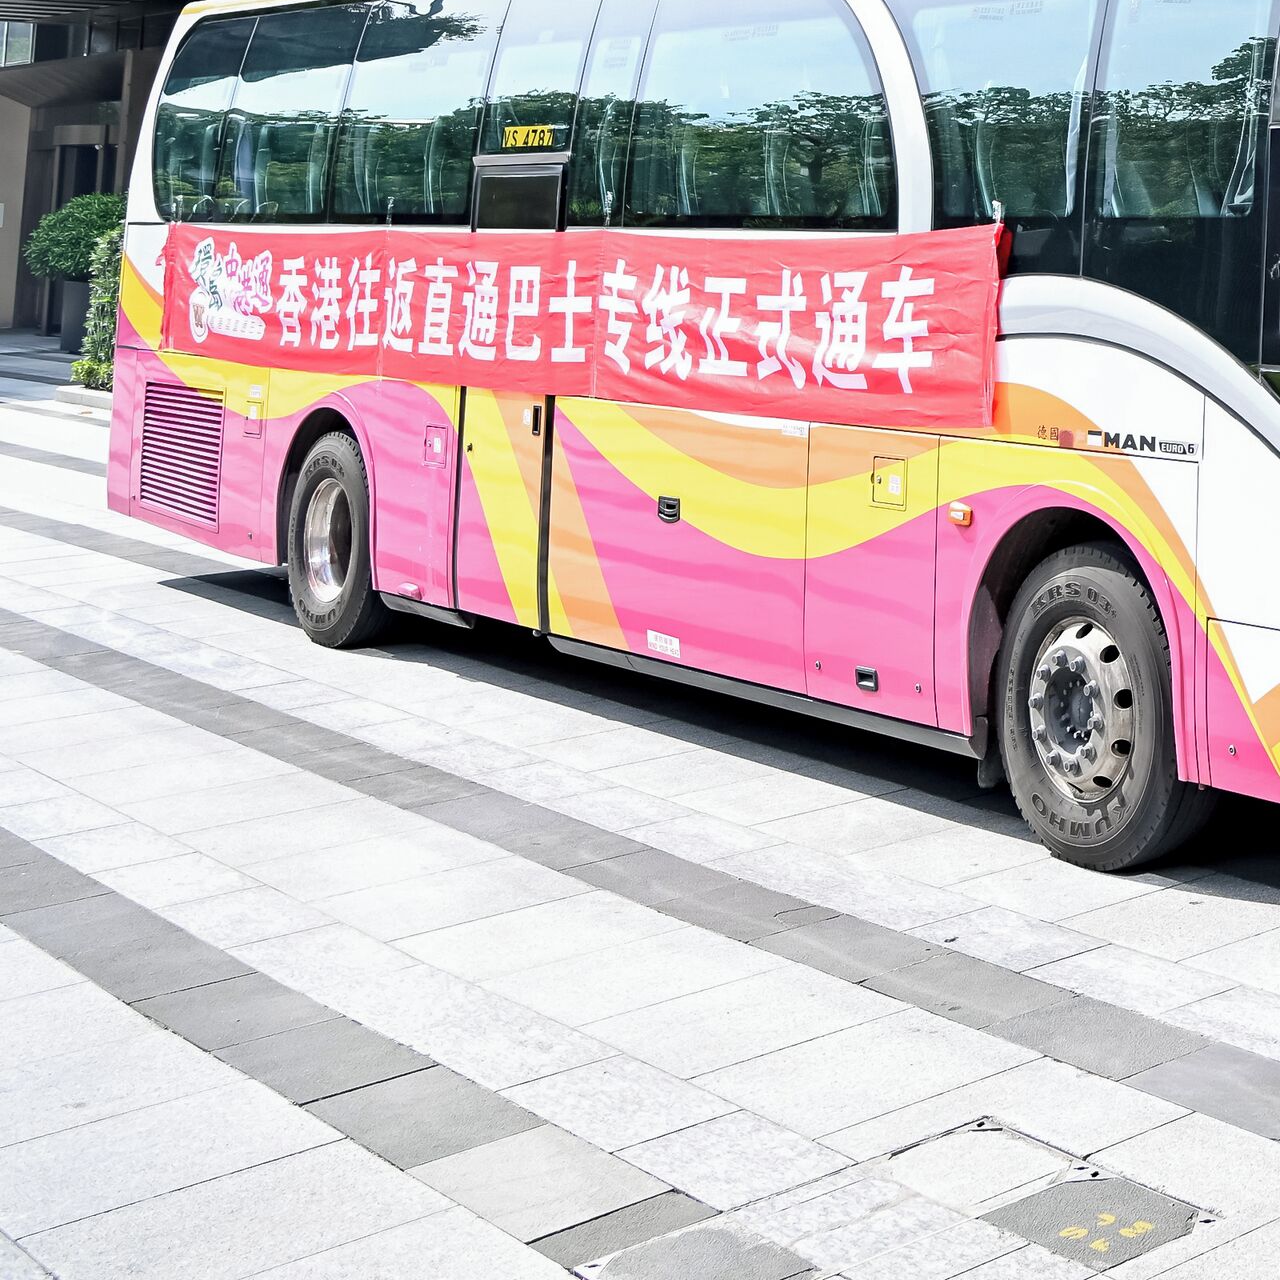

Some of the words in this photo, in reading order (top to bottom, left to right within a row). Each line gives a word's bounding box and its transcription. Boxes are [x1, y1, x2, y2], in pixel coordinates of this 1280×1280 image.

[503, 128, 518, 147] VS
[523, 129, 553, 146] 4787
[275, 255, 935, 395] 香港往返直通巴士专线正式通车
[1037, 424, 1059, 441] 德國
[1104, 432, 1156, 452] MAN
[1161, 442, 1183, 454] EURO
[1187, 443, 1195, 454] 6
[1030, 582, 1081, 618] KRS
[1031, 793, 1132, 839] KUMHO
